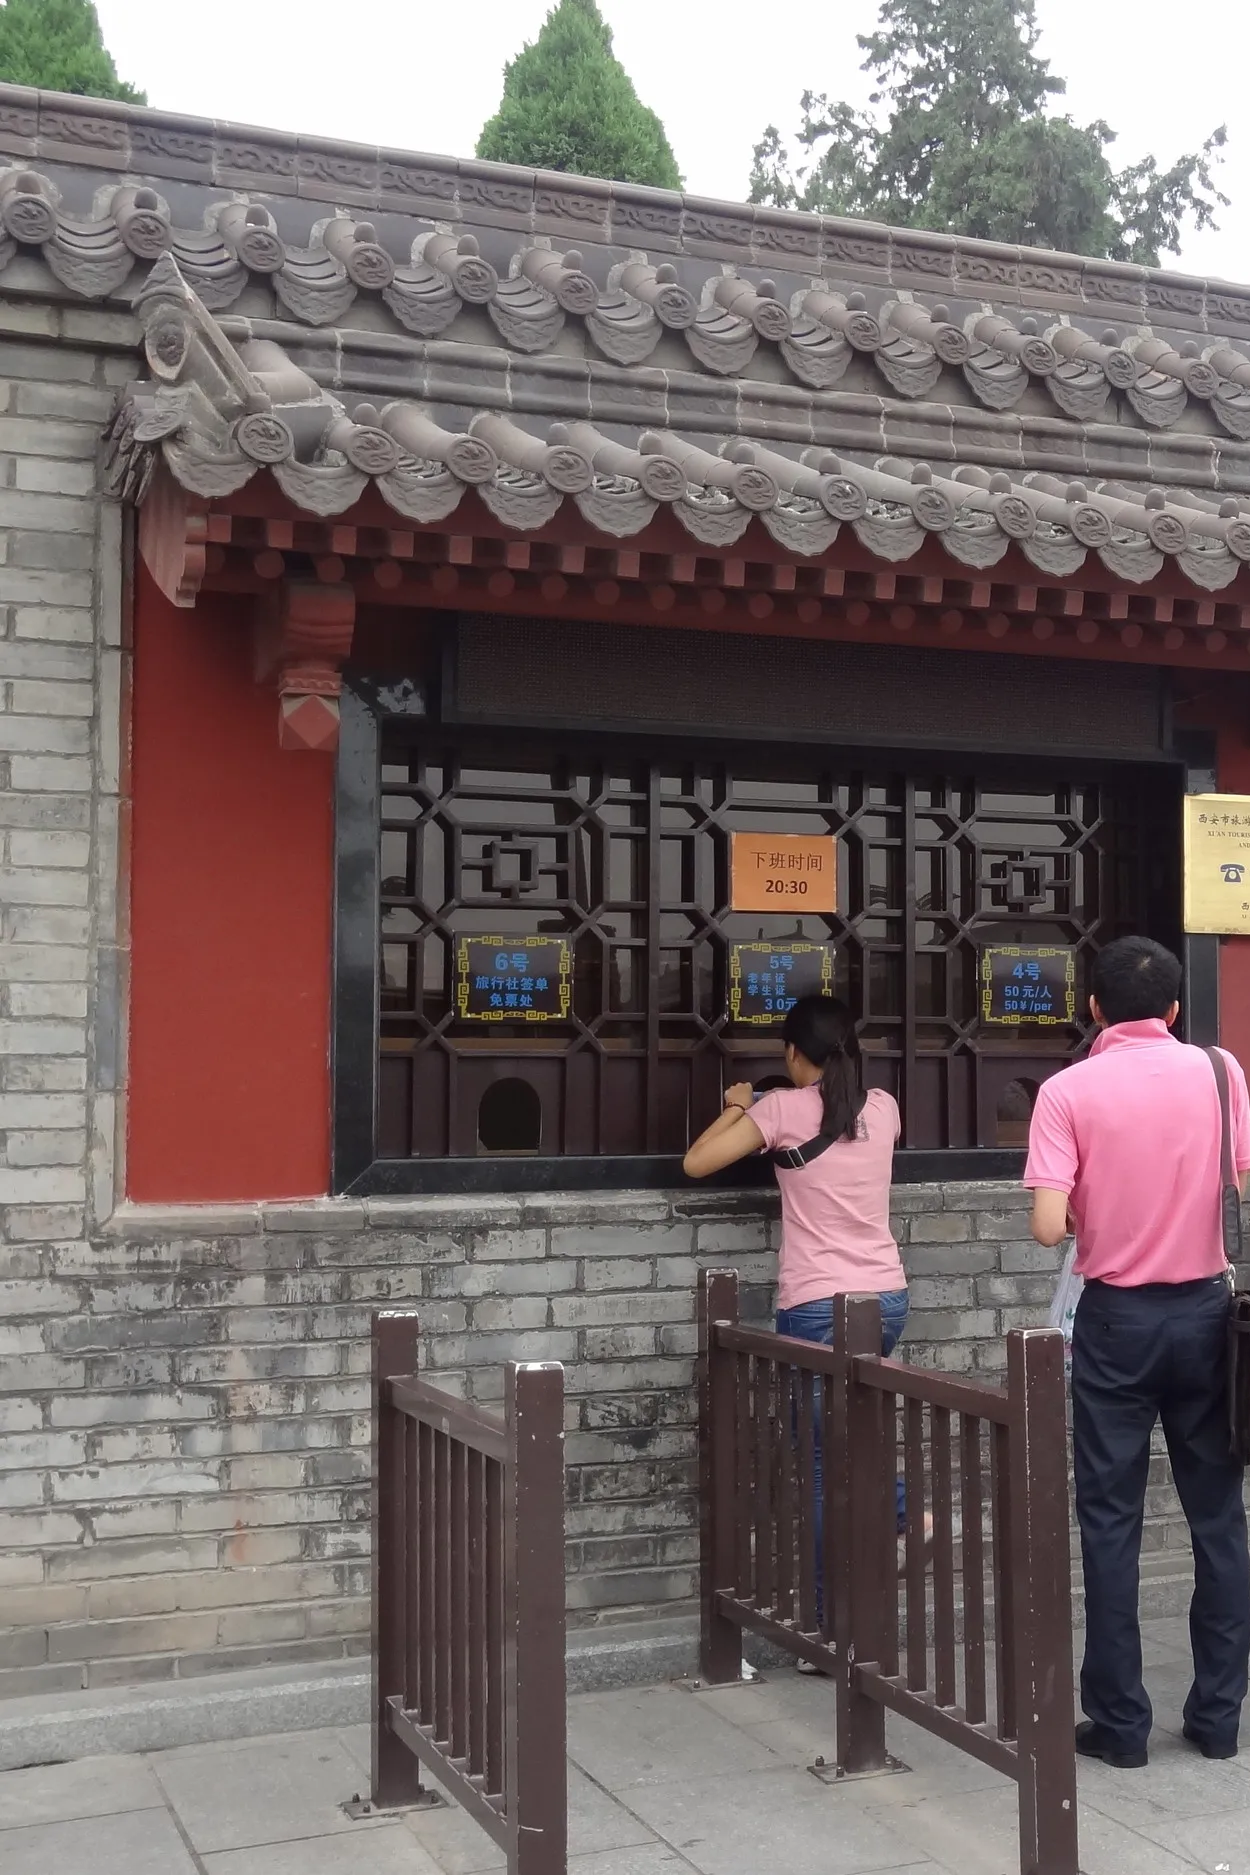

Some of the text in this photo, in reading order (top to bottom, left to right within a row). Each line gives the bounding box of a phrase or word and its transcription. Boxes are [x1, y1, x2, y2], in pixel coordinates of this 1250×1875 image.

[750, 851, 823, 872] 下班时间
[765, 879, 808, 895] 20:30
[495, 952, 530, 973] 6号
[769, 955, 795, 971] 5号
[1012, 962, 1041, 981] 4号
[475, 976, 549, 991] 旅行社签单
[489, 992, 533, 1008] 免票处
